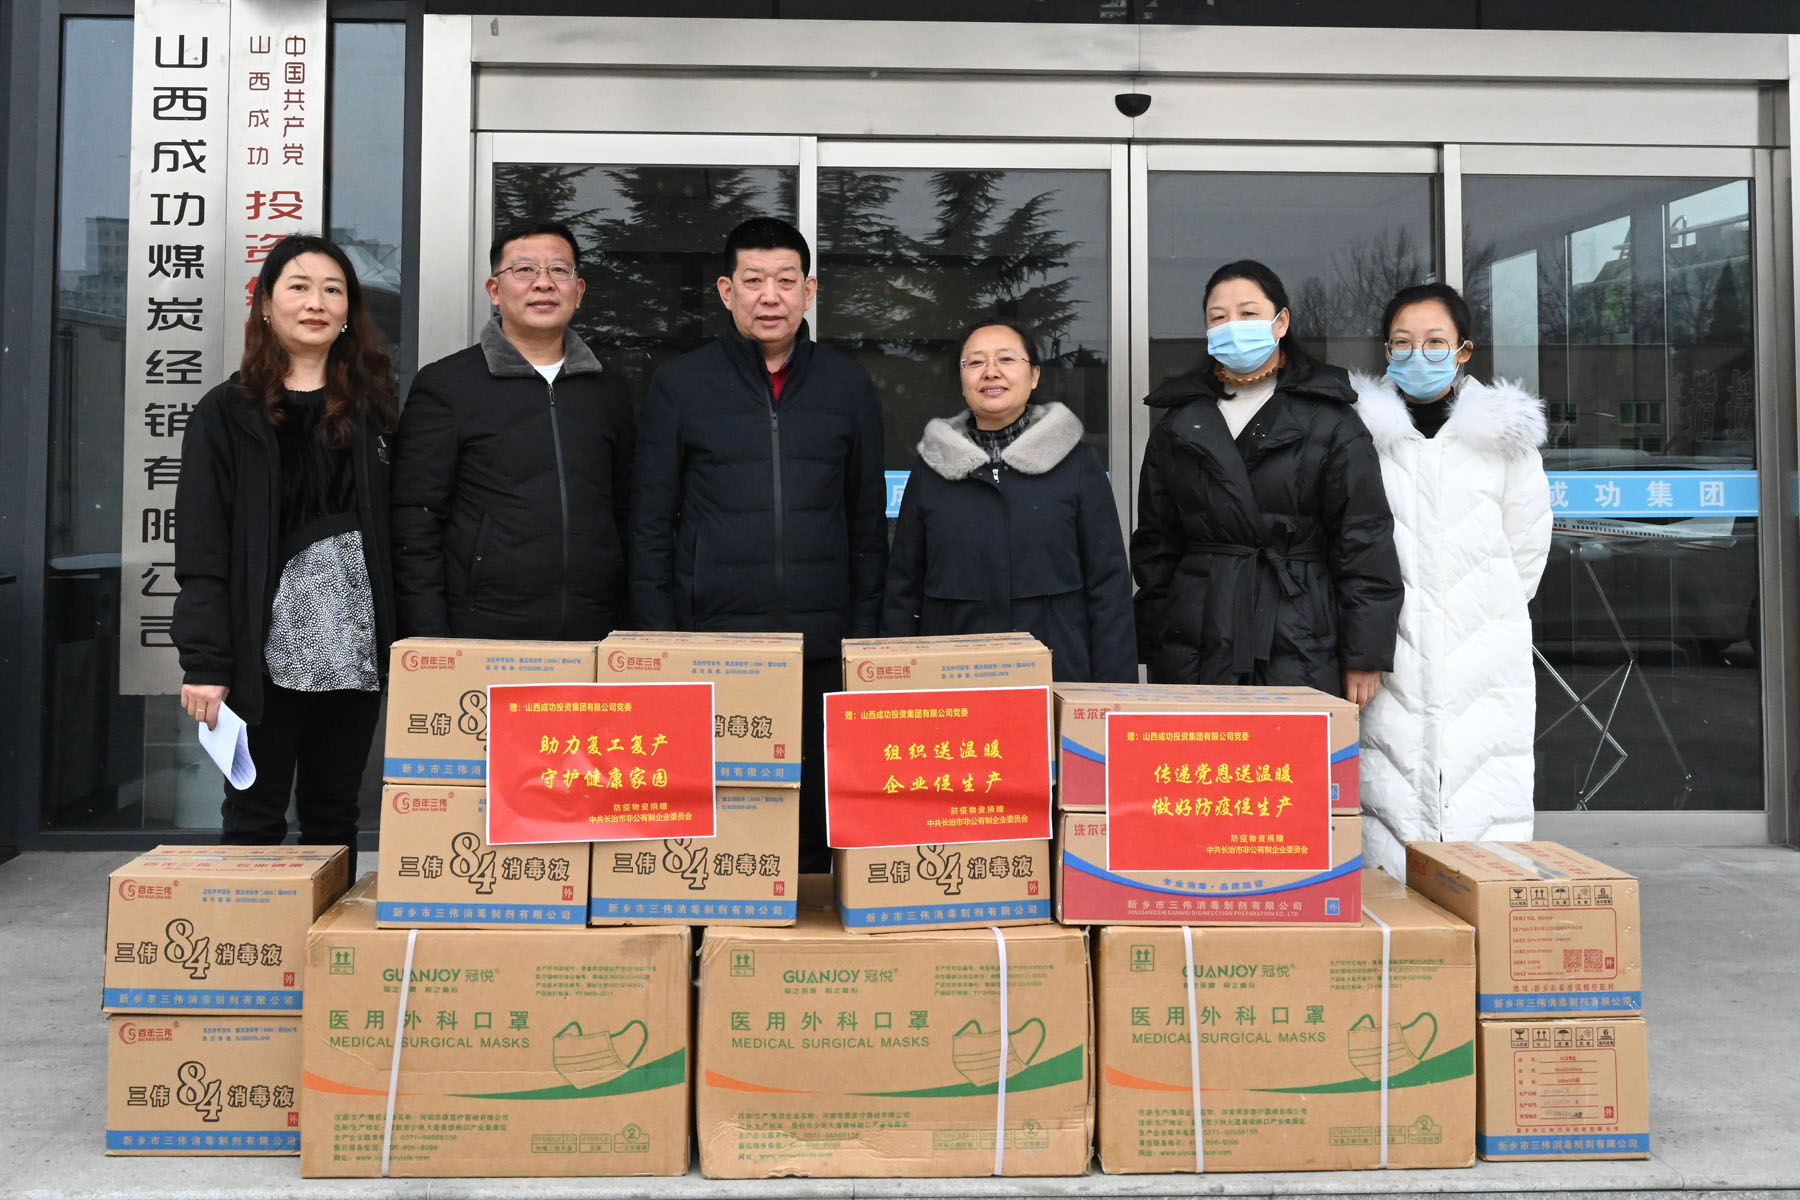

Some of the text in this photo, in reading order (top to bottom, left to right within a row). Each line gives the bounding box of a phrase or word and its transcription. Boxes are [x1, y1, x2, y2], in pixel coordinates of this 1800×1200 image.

[247, 34, 271, 166] 山西成功
[283, 34, 307, 166] 中国共产党
[140, 34, 209, 648] 山西成功煤炭经销有限公司
[1549, 480, 1725, 508] 成功集团
[421, 656, 456, 665] 百年三伟
[627, 656, 662, 667] 百年三伟
[876, 665, 911, 675] 百年三伟
[539, 733, 668, 756] 助力复工复产
[883, 739, 1003, 761] 组织送温暖
[540, 767, 668, 789] 守护健康家园
[1153, 763, 1294, 785] 传递党恩送温暖
[882, 770, 1003, 794] 企业促生产
[412, 798, 448, 807] 百年三伟
[613, 802, 668, 812] 防疫物资捐赠
[1151, 796, 1293, 818] 做好防疫促生产
[950, 805, 1005, 815] 防疫物资捐赠
[588, 812, 692, 824] 中共长治市非公有制企业委员会
[926, 814, 1028, 828] 中共长治市非公有制企业委员会
[1230, 834, 1285, 843] 防疫物资捐赠
[1206, 845, 1309, 855] 中共长治市非公有制企业委员会
[138, 885, 172, 895] 百年三伟
[1127, 900, 1303, 911] 新乡市三伟消毒制剂有限公司
[383, 968, 495, 983] GUANJOY 冠悦
[783, 969, 894, 983] GUANJOY 冠悦
[1261, 964, 1290, 978] 冠悦
[329, 1010, 531, 1031] 医用外科口罩
[730, 1010, 930, 1031] 医用外科口罩
[1131, 1005, 1326, 1026] 医用外科口罩
[138, 1028, 173, 1037] 百年三伟
[1132, 1031, 1326, 1044] MEDICAL SURGICAL MASKS
[329, 1036, 530, 1049] MEDICAL SURGICAL MASKS
[732, 1036, 930, 1049] MEDICAL SURGICAL MASKS
